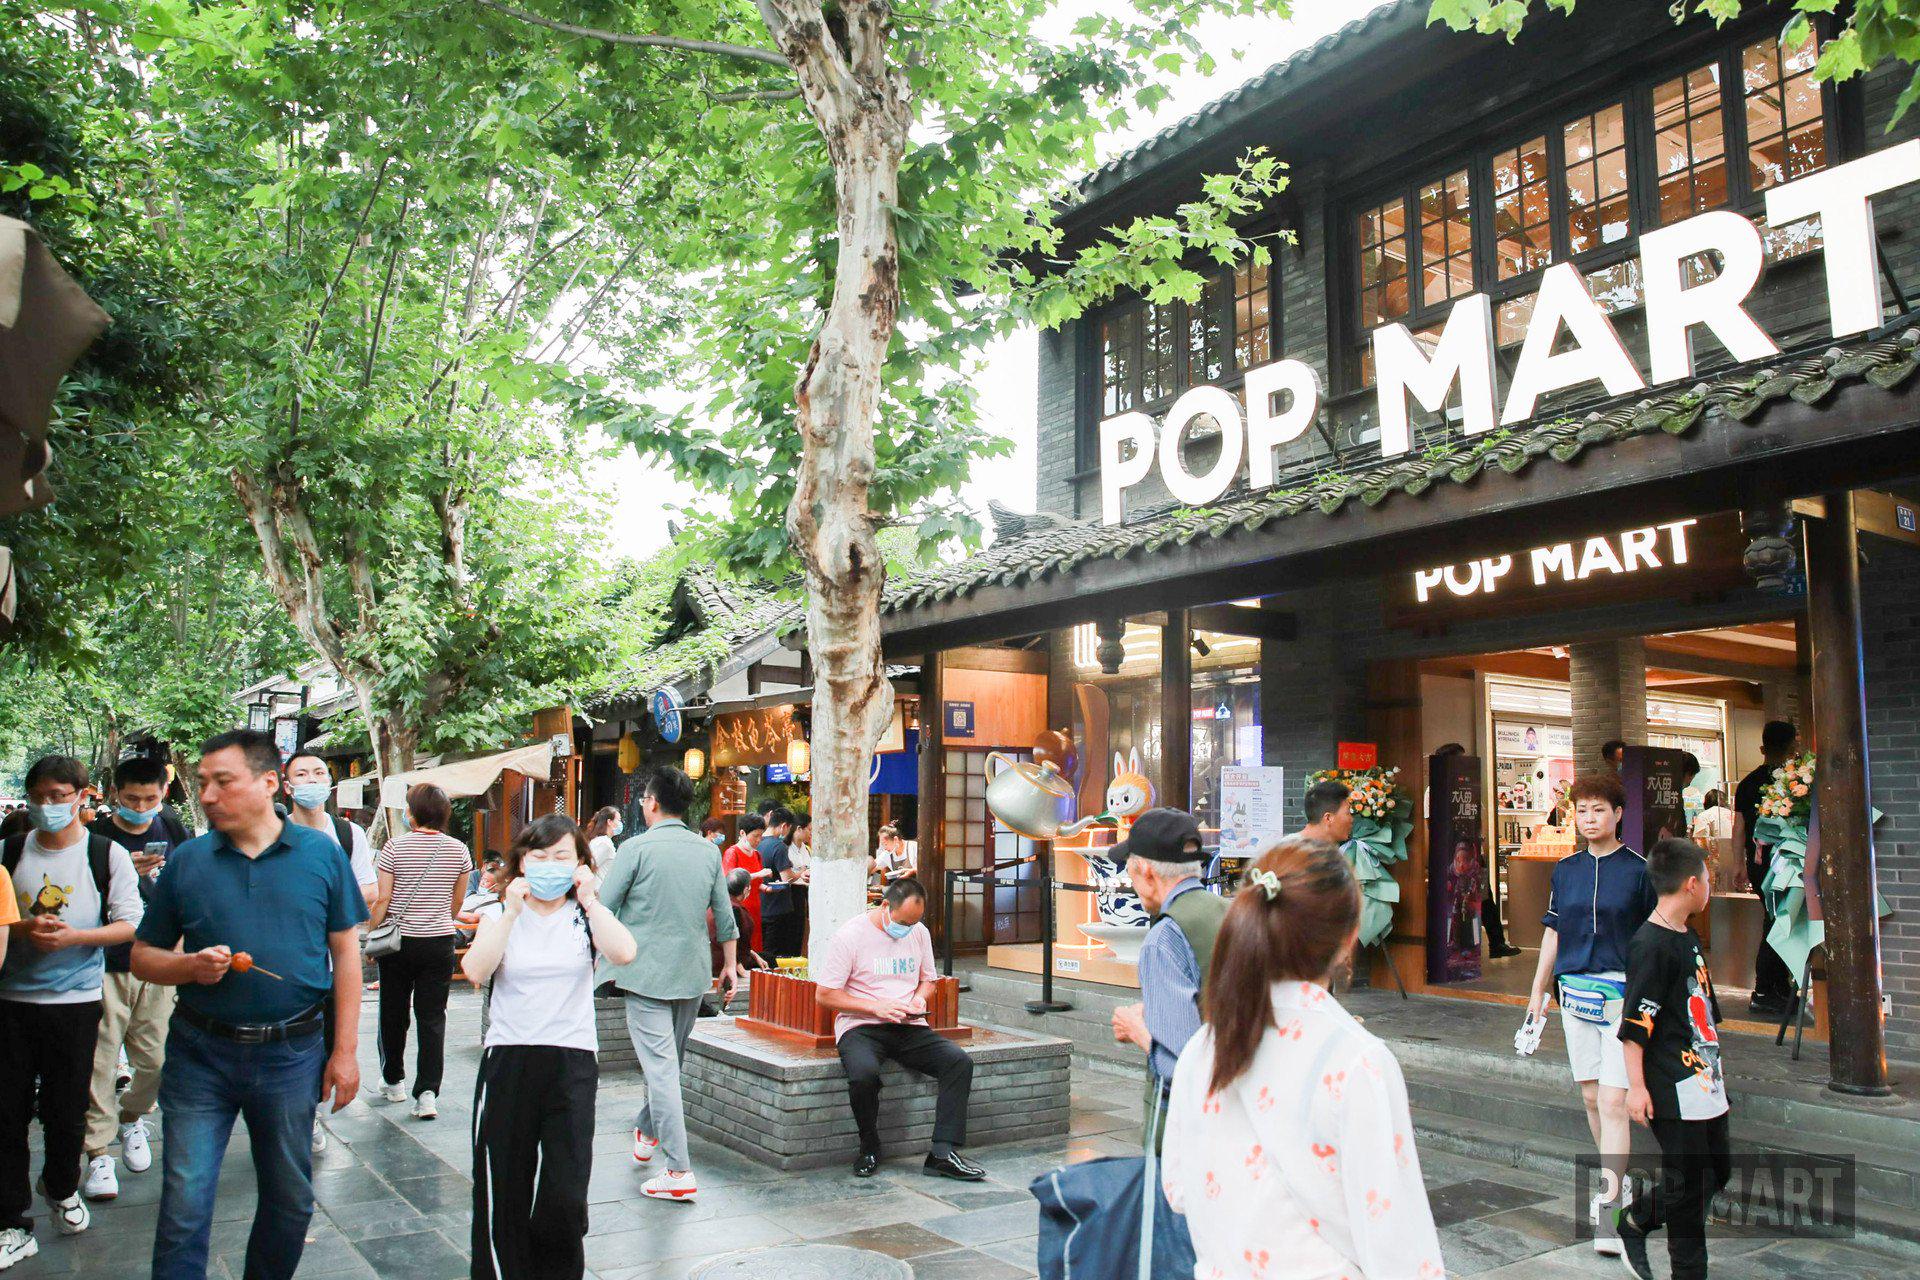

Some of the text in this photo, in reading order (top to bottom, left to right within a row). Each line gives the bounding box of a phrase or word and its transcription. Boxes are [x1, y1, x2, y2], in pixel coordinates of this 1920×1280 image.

[1099, 138, 1920, 527] POP MART
[1415, 518, 1697, 602] POP MART
[1451, 790, 1472, 803] 大人的
[1647, 776, 1672, 791] 大人的
